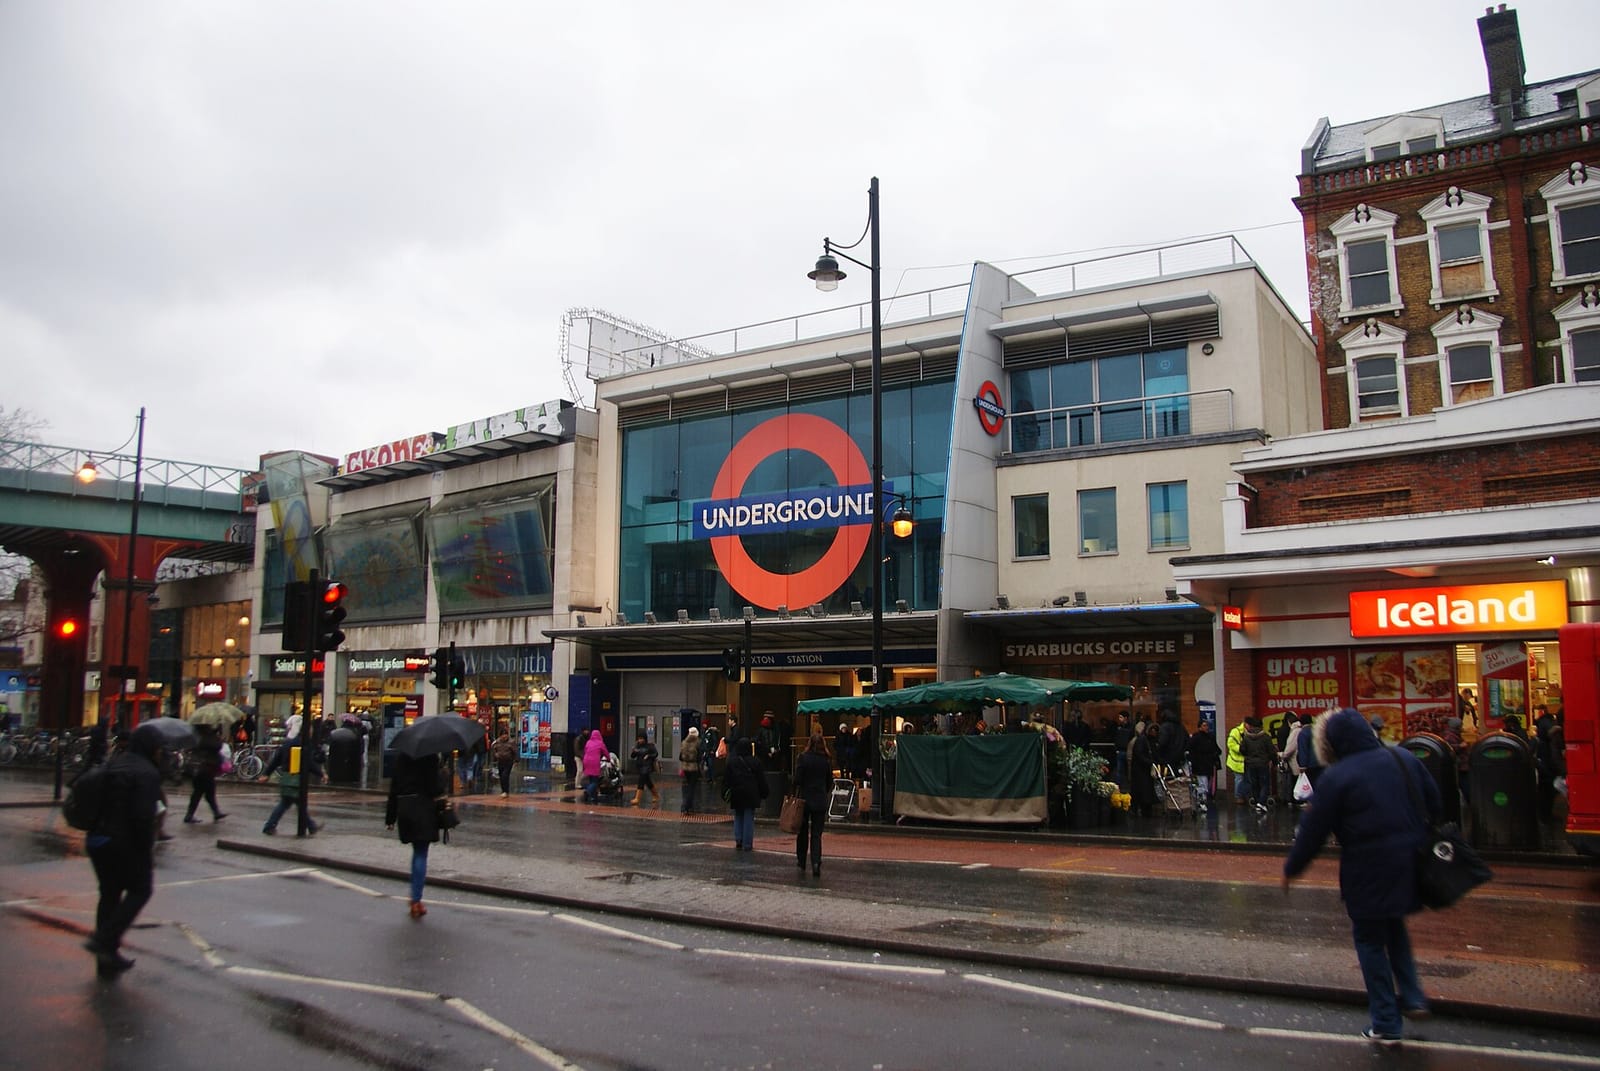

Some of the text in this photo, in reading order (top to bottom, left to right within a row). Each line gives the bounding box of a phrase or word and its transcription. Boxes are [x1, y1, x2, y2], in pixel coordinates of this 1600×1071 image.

[702, 492, 875, 530] UNDERGROUND
[1377, 590, 1537, 628] Iceland
[1006, 640, 1176, 657] STARBUCKS COFFEE
[350, 659, 366, 671] Open
[365, 658, 392, 671] weekdys
[786, 654, 823, 664] STATION
[1267, 656, 1337, 677] great
[1267, 676, 1339, 696] value
[1267, 697, 1339, 709] everyday!
